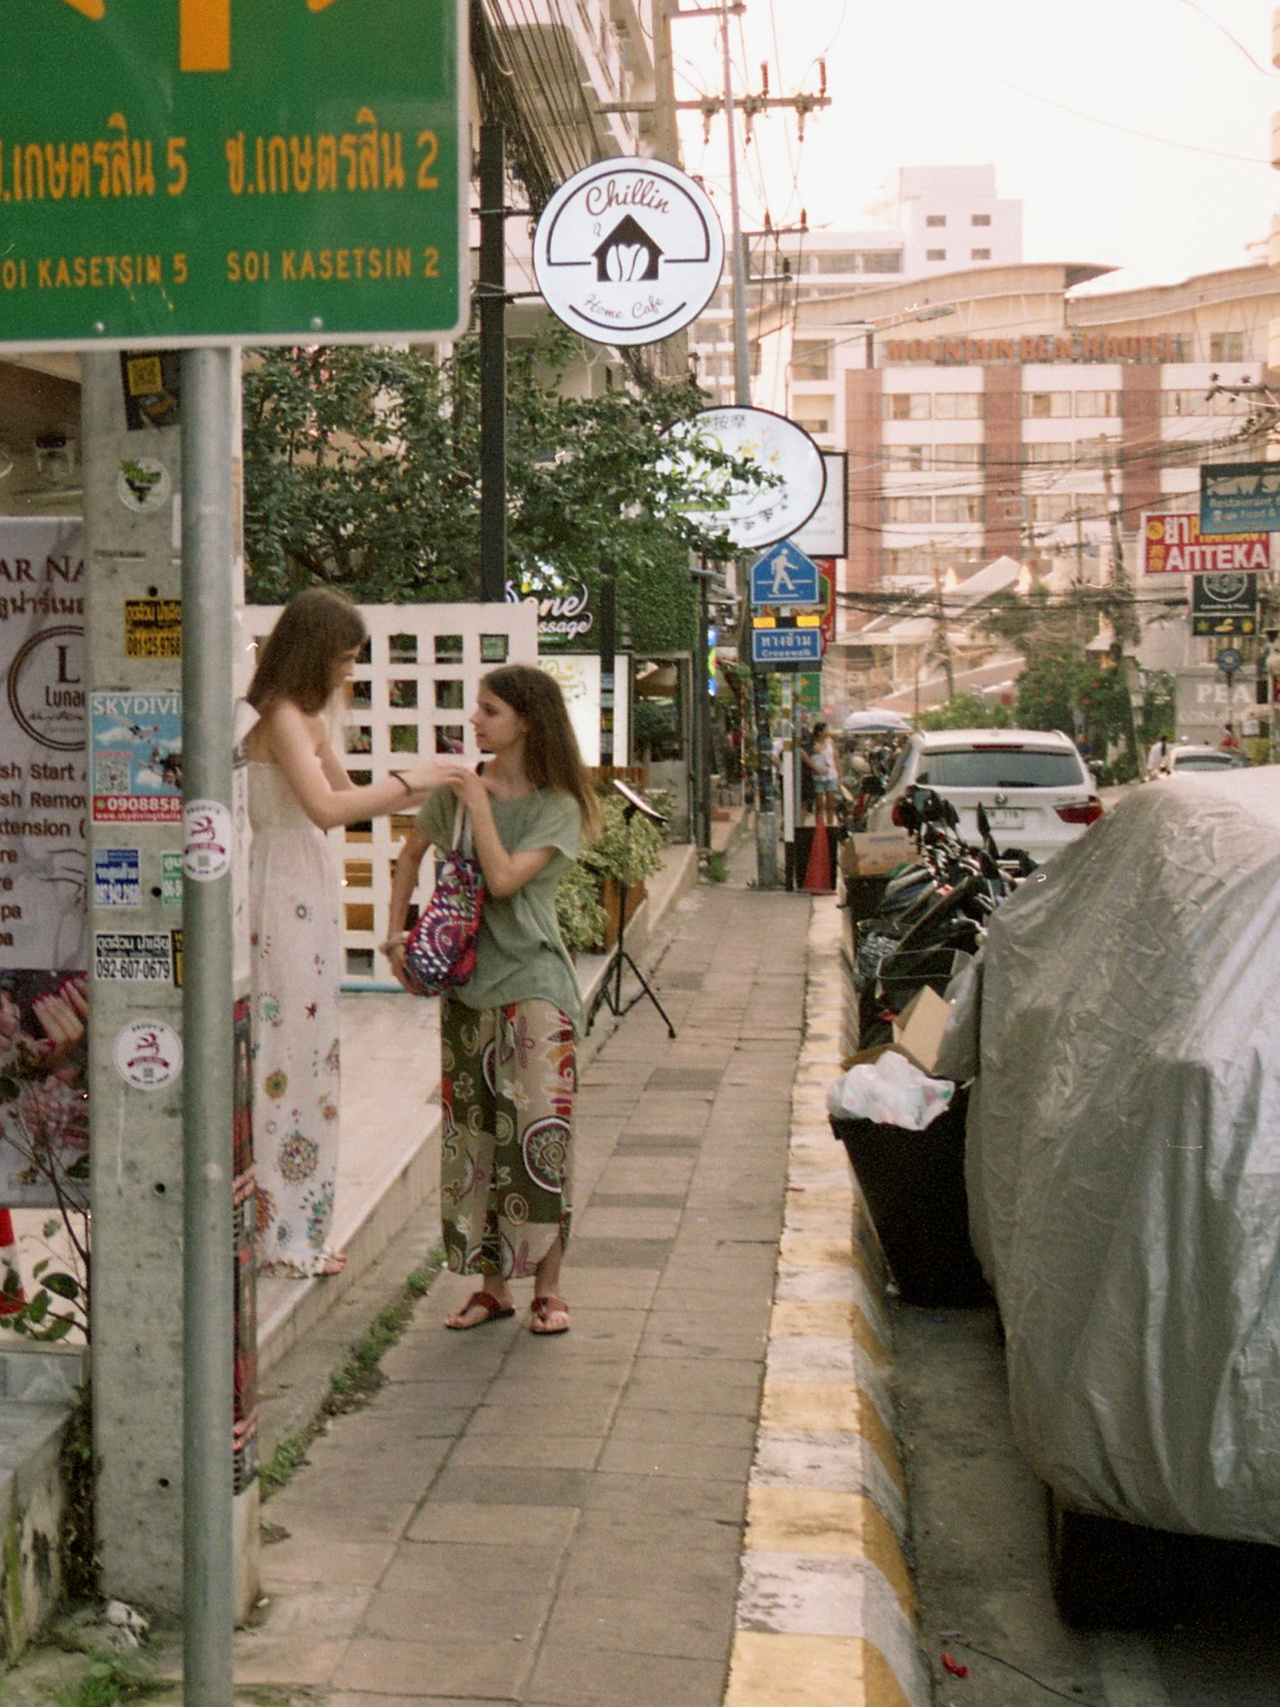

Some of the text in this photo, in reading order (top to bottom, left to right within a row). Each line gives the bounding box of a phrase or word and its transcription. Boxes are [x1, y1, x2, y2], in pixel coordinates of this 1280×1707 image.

[166, 137, 188, 196] 5
[417, 131, 439, 190] 2
[585, 178, 670, 217] Chillin
[38, 254, 162, 288] KASETSIN
[173, 254, 188, 284] 5
[227, 248, 439, 281] SOI KASETSIN 2
[585, 293, 664, 319] Home Cafe
[886, 338, 1015, 361] MOUNTAIN
[539, 611, 593, 640] ssage
[57, 645, 80, 683] L
[93, 697, 183, 716] SKYDIVI
[31, 764, 75, 781] Start
